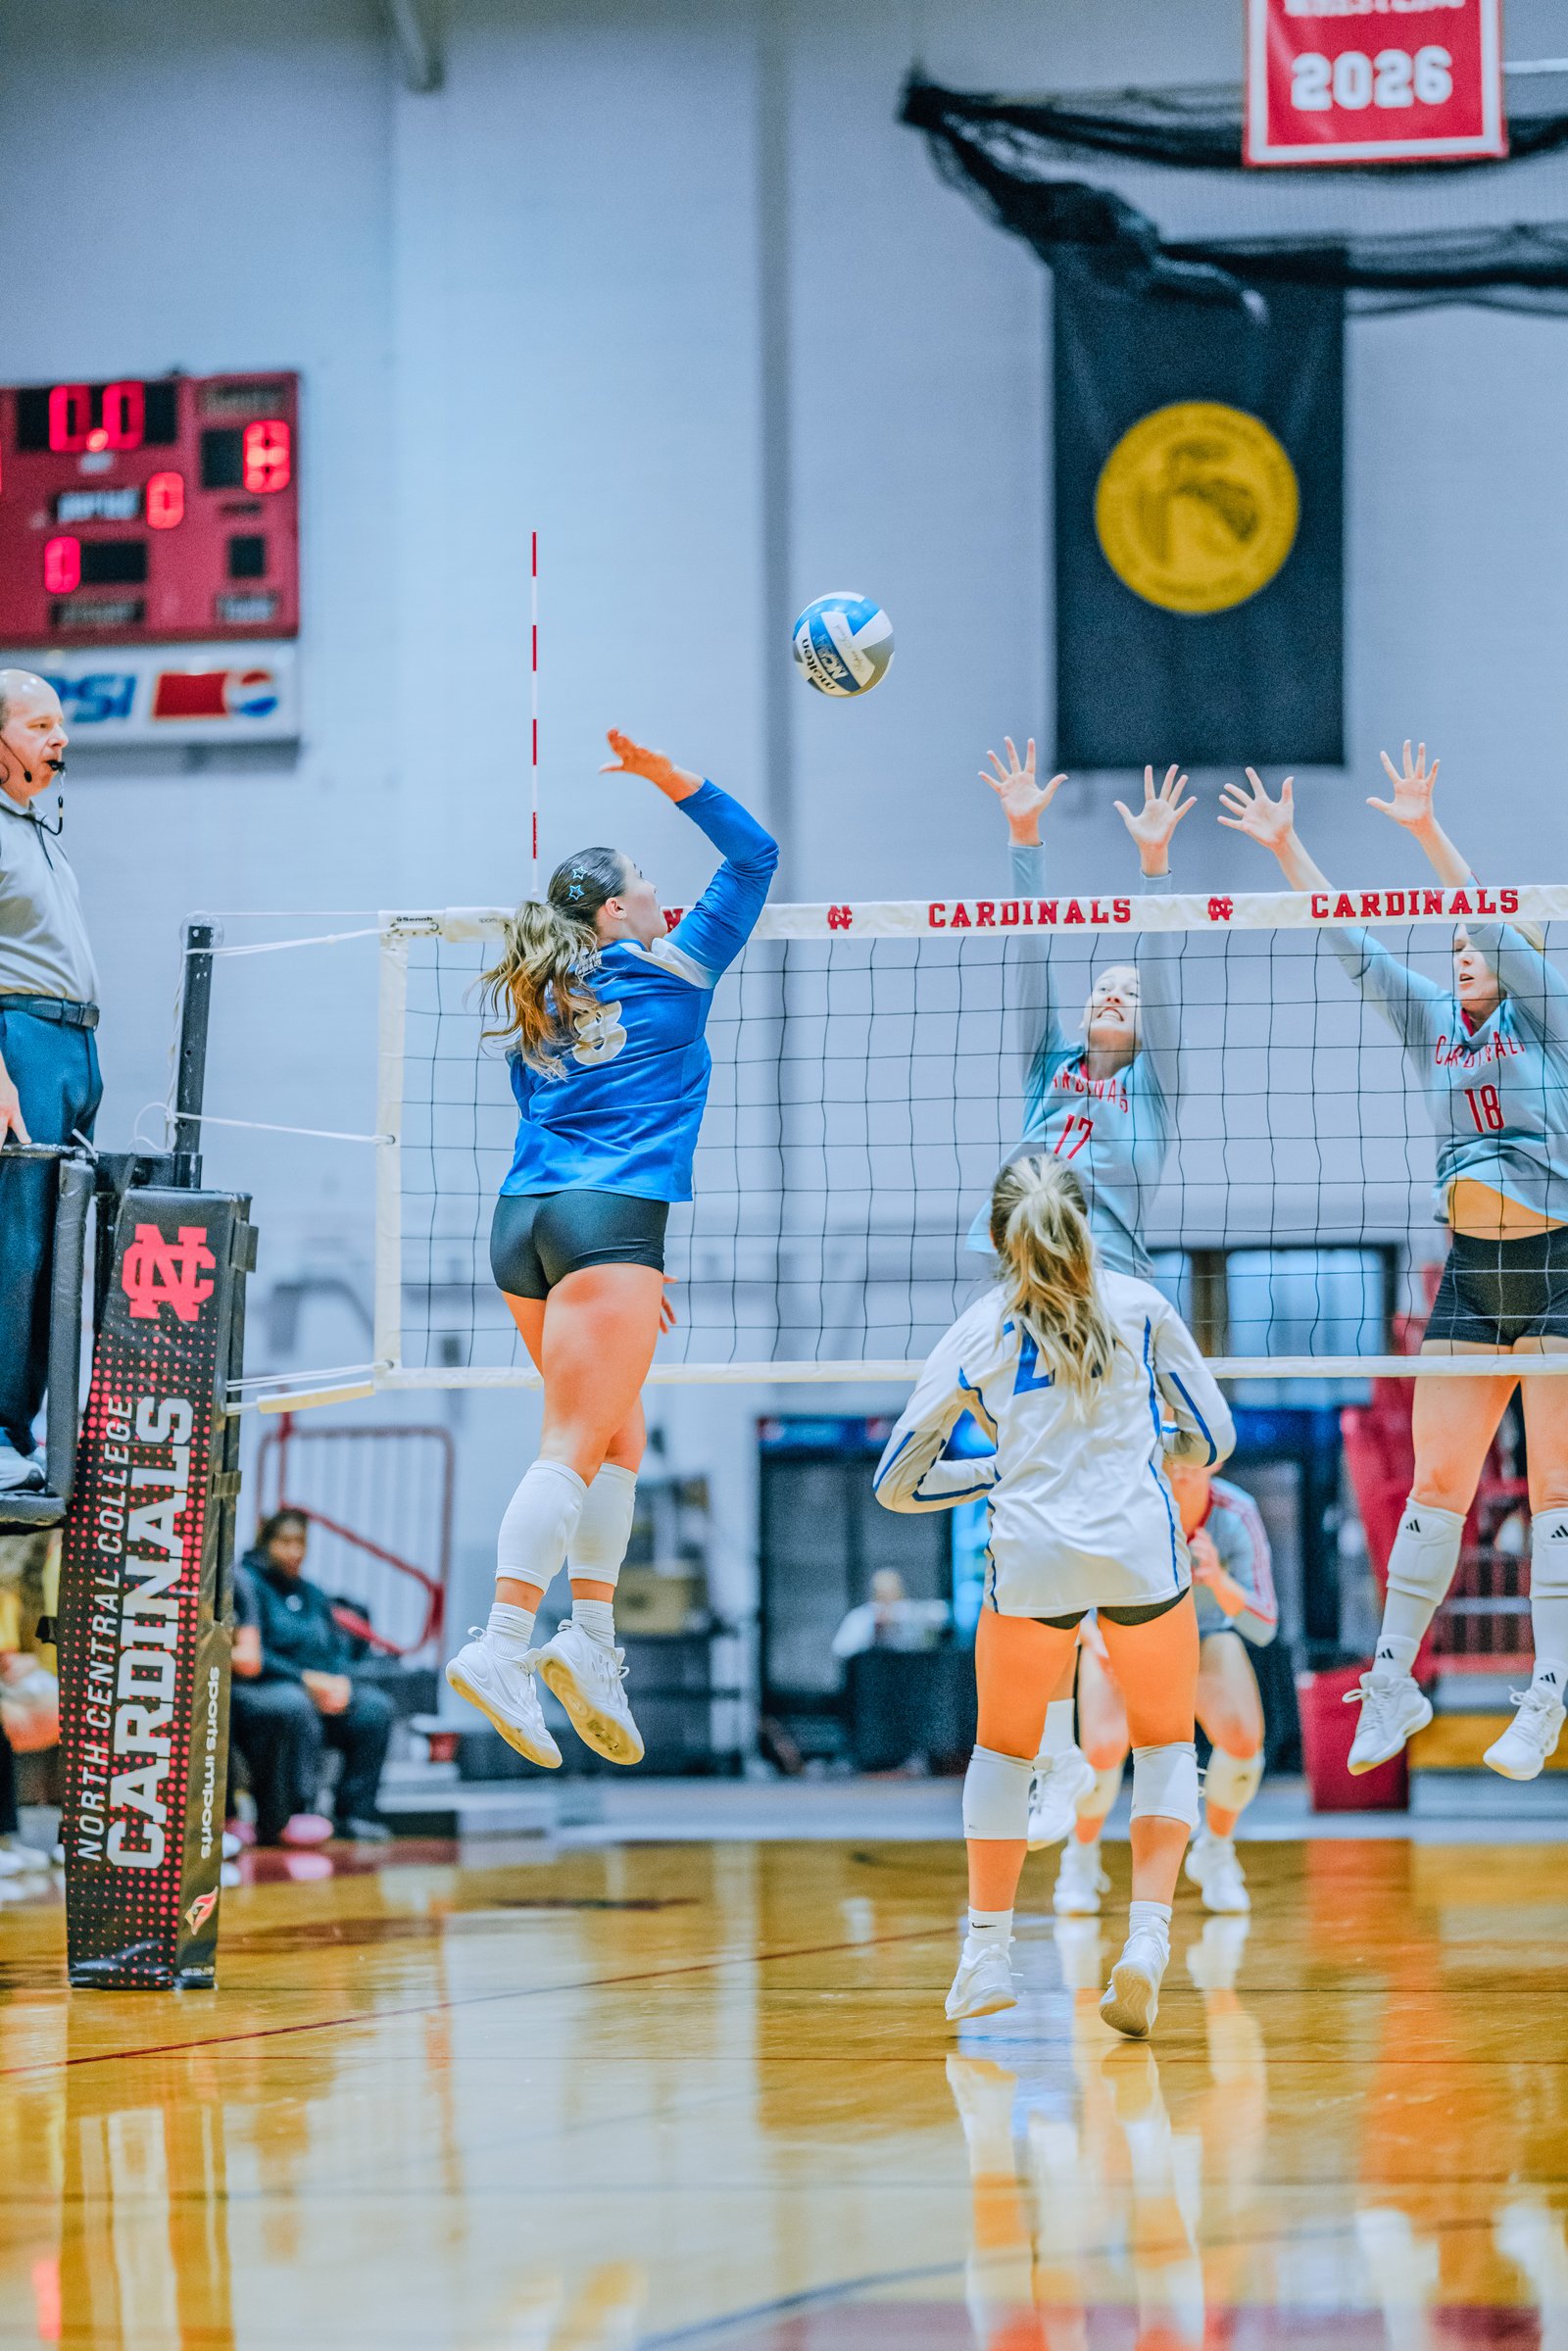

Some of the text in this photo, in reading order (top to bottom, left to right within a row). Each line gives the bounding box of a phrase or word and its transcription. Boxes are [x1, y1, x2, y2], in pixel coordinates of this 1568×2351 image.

[1291, 45, 1452, 111] 2026
[802, 638, 836, 690] molten
[928, 898, 1132, 928] CARDINALS
[1311, 889, 1519, 919] CARDINALS
[1464, 1084, 1505, 1134] 18
[1054, 1114, 1095, 1160] 17
[77, 1396, 132, 1861] NORTH CENTRAL COLLEGE
[107, 1396, 194, 1869] CARDINALS
[201, 1666, 220, 1859] sports imports
